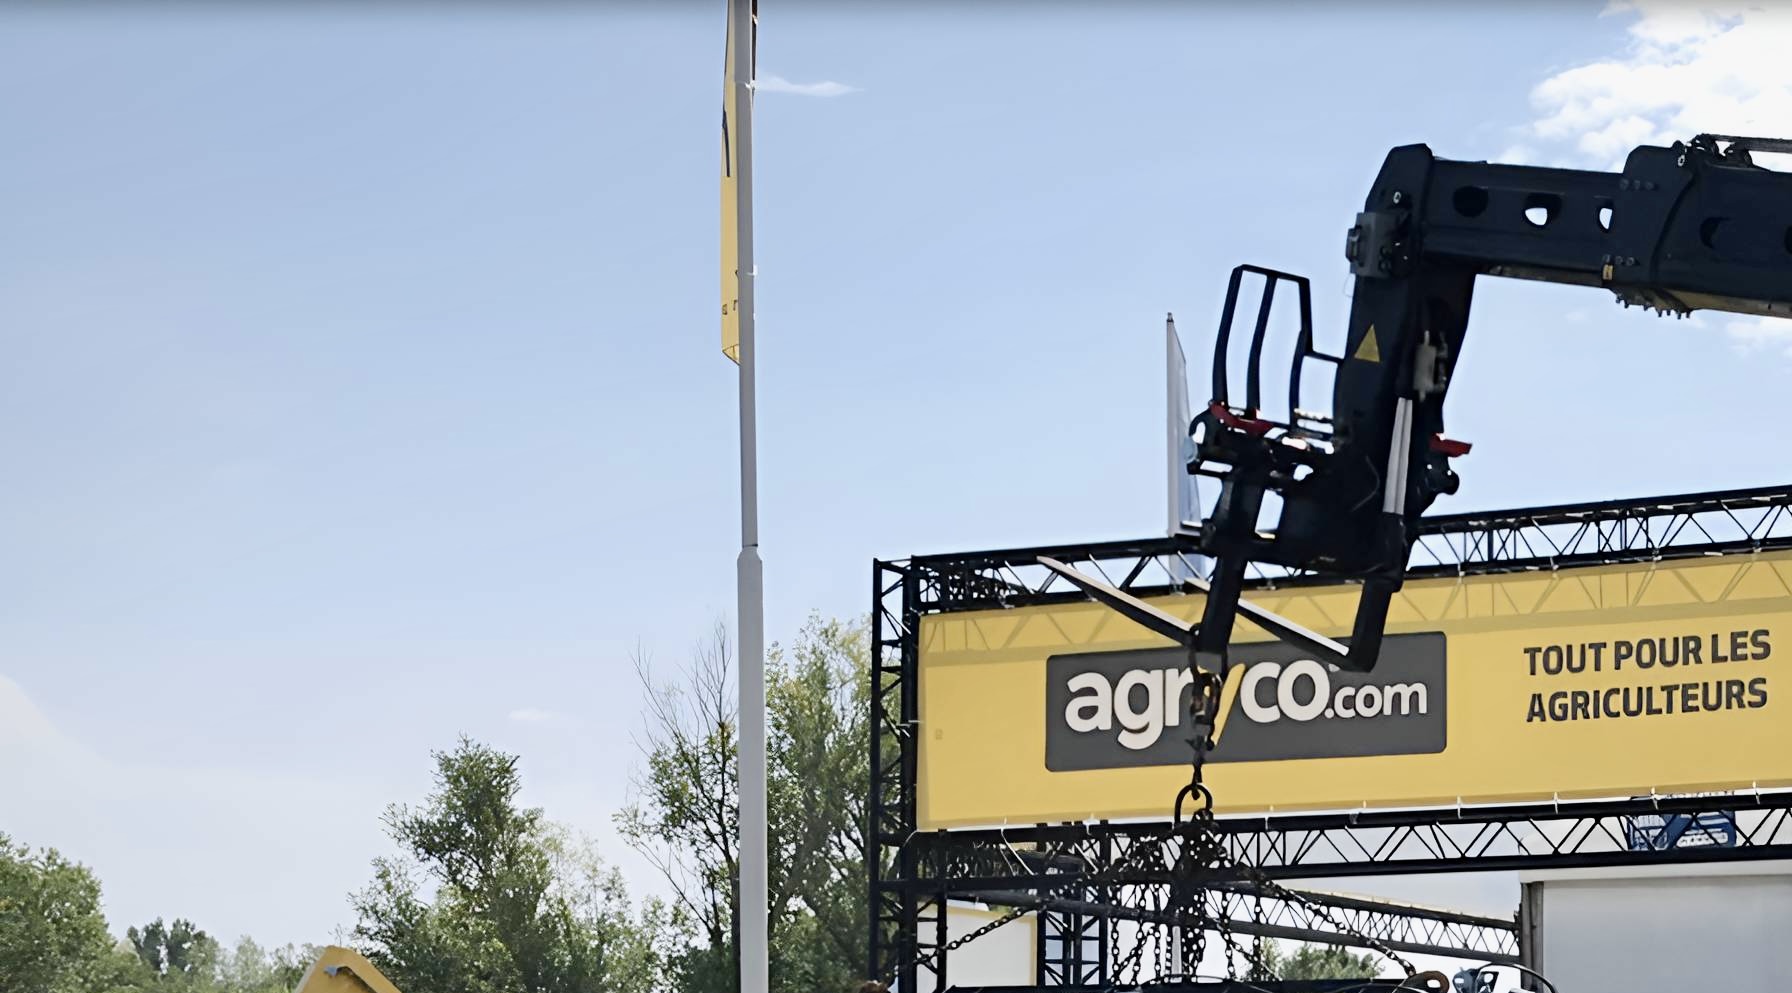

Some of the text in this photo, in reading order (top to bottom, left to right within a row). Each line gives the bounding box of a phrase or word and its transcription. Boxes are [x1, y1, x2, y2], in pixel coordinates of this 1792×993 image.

[1523, 629, 1772, 676] TOUT POUR LES
[1526, 677, 1768, 723] AGRICULTEURS
